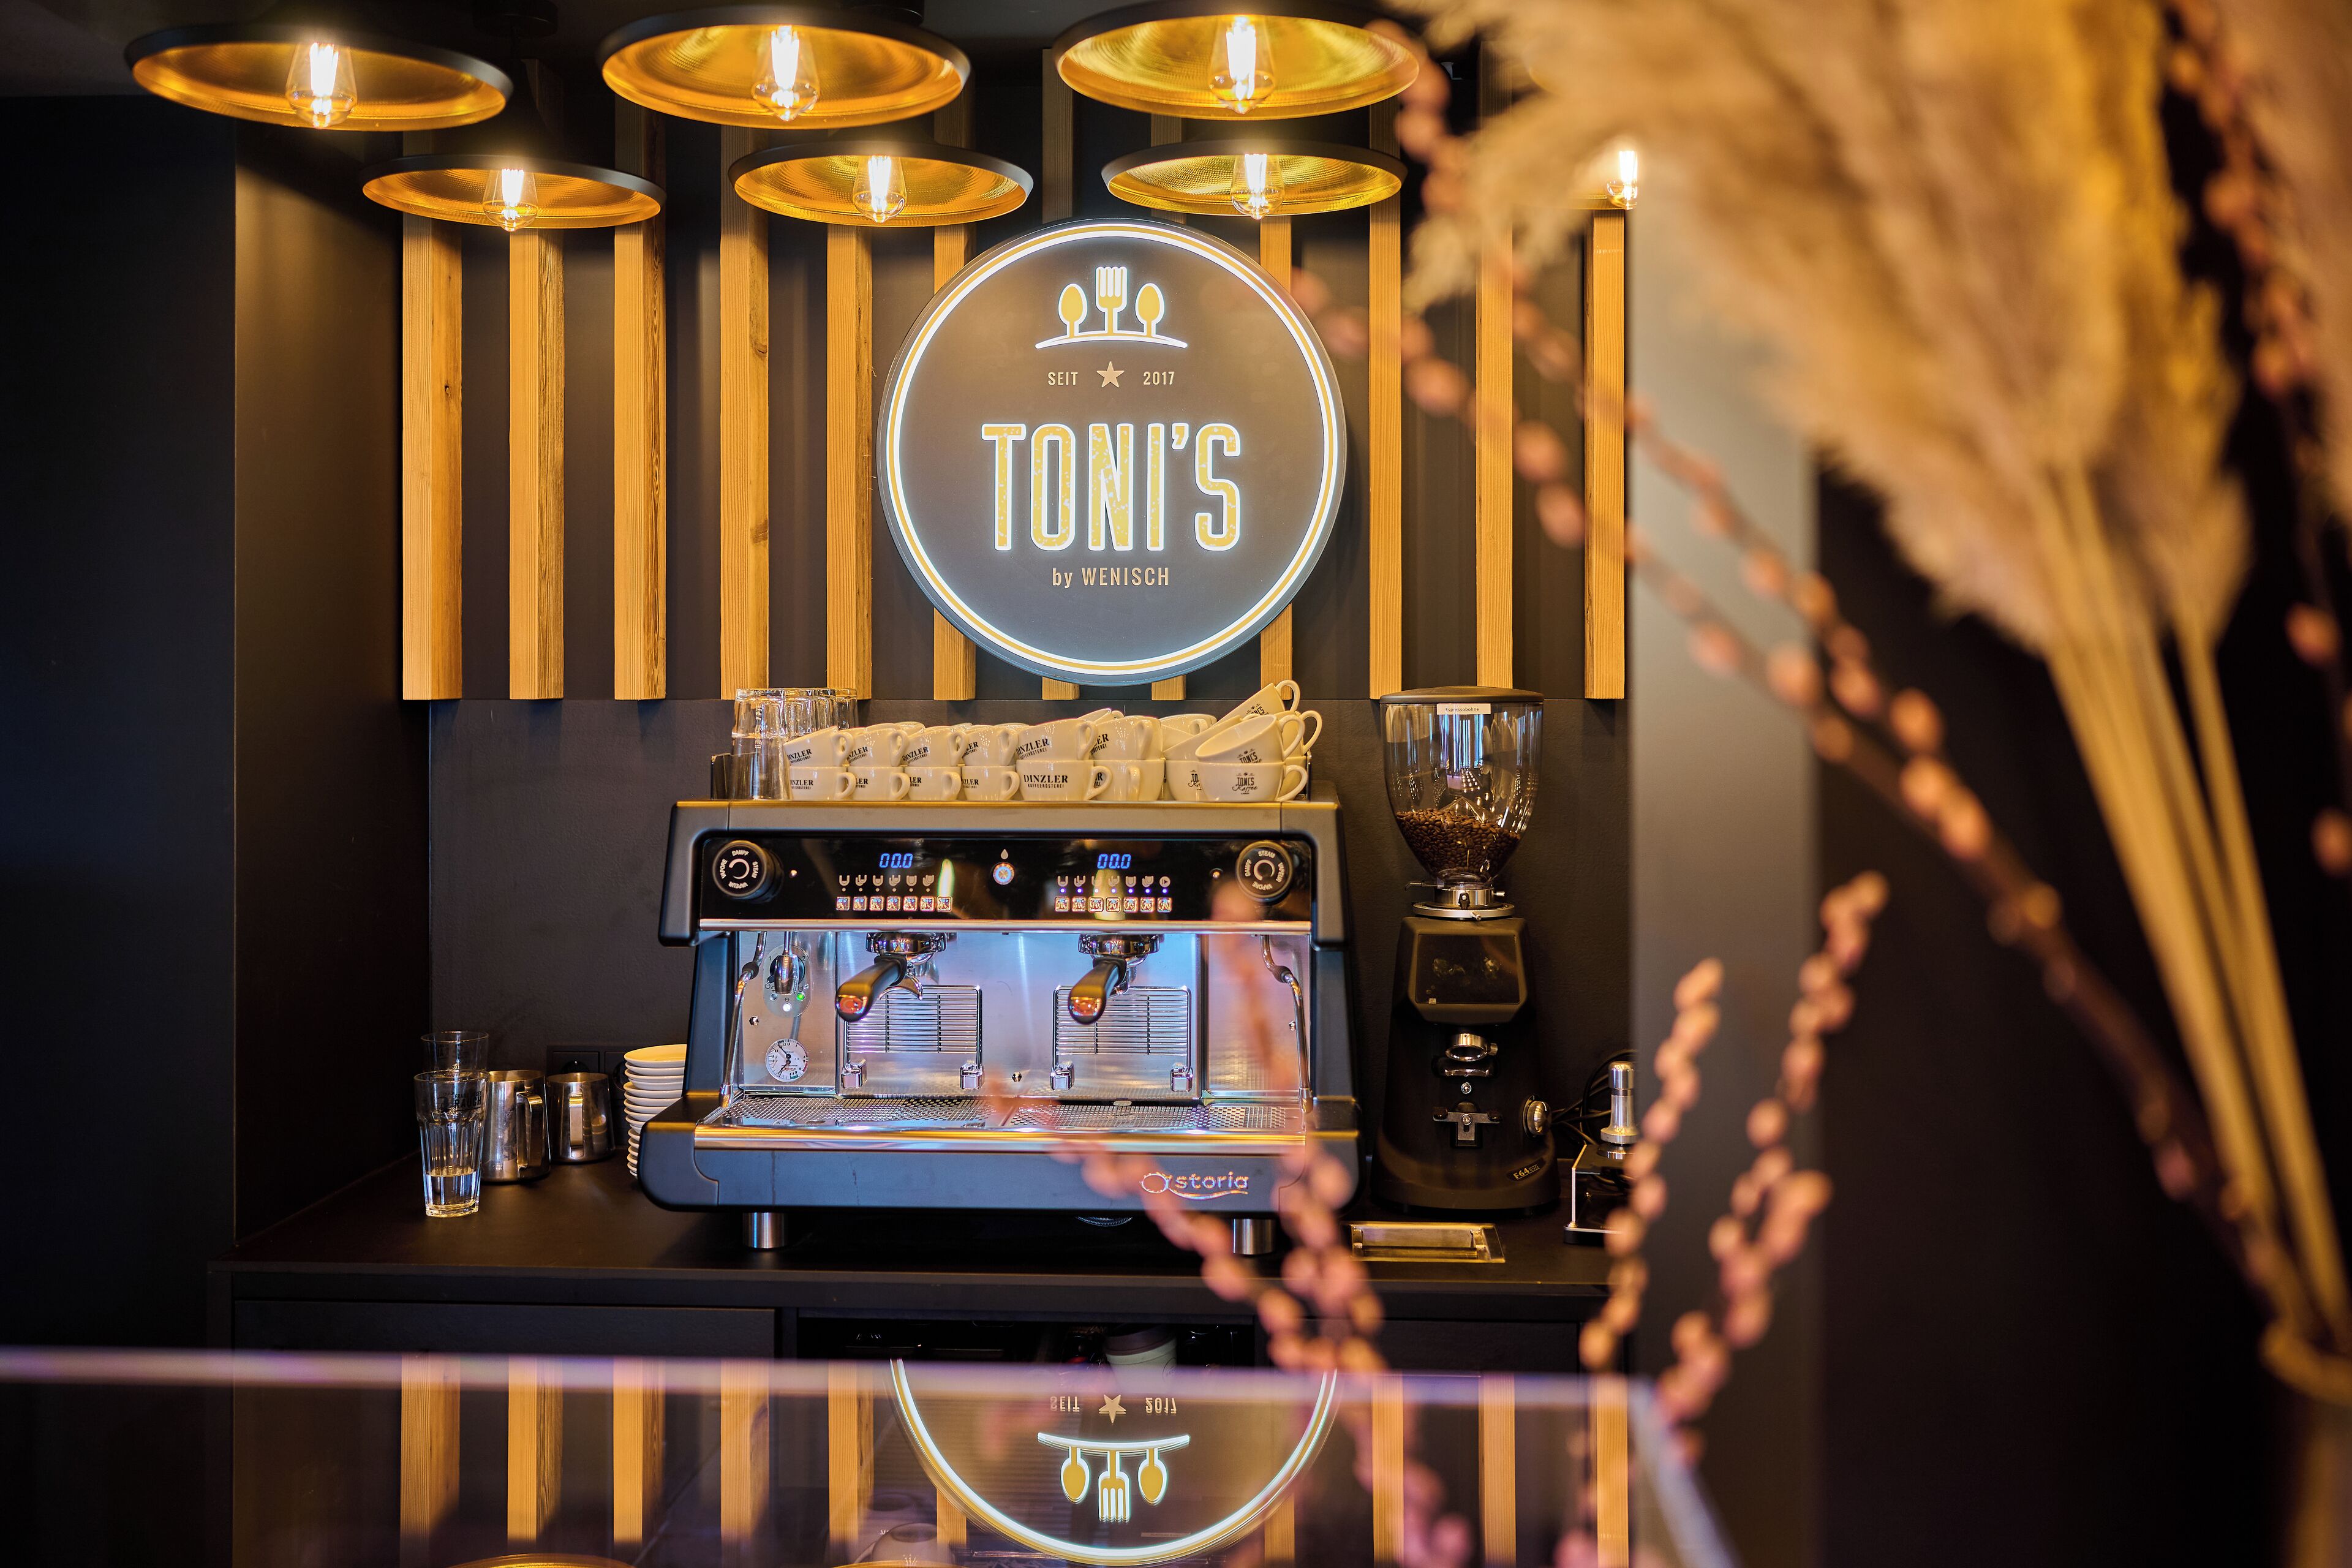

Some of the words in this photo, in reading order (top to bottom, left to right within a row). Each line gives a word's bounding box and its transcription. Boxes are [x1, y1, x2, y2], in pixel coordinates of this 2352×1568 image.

[1047, 372, 1078, 385] SEIT
[1143, 371, 1175, 385] 2017
[981, 423, 1241, 552] TONI'S
[1052, 568, 1072, 589] by
[1082, 567, 1169, 586] WENISCH
[1016, 738, 1049, 755] DINZLER
[1023, 775, 1068, 783] DINZLER
[879, 853, 913, 869] 00.0
[1097, 854, 1131, 869] 00.0
[1258, 850, 1276, 859] STEAM
[1252, 881, 1273, 891] VAPORE
[1513, 1168, 1529, 1180] F64
